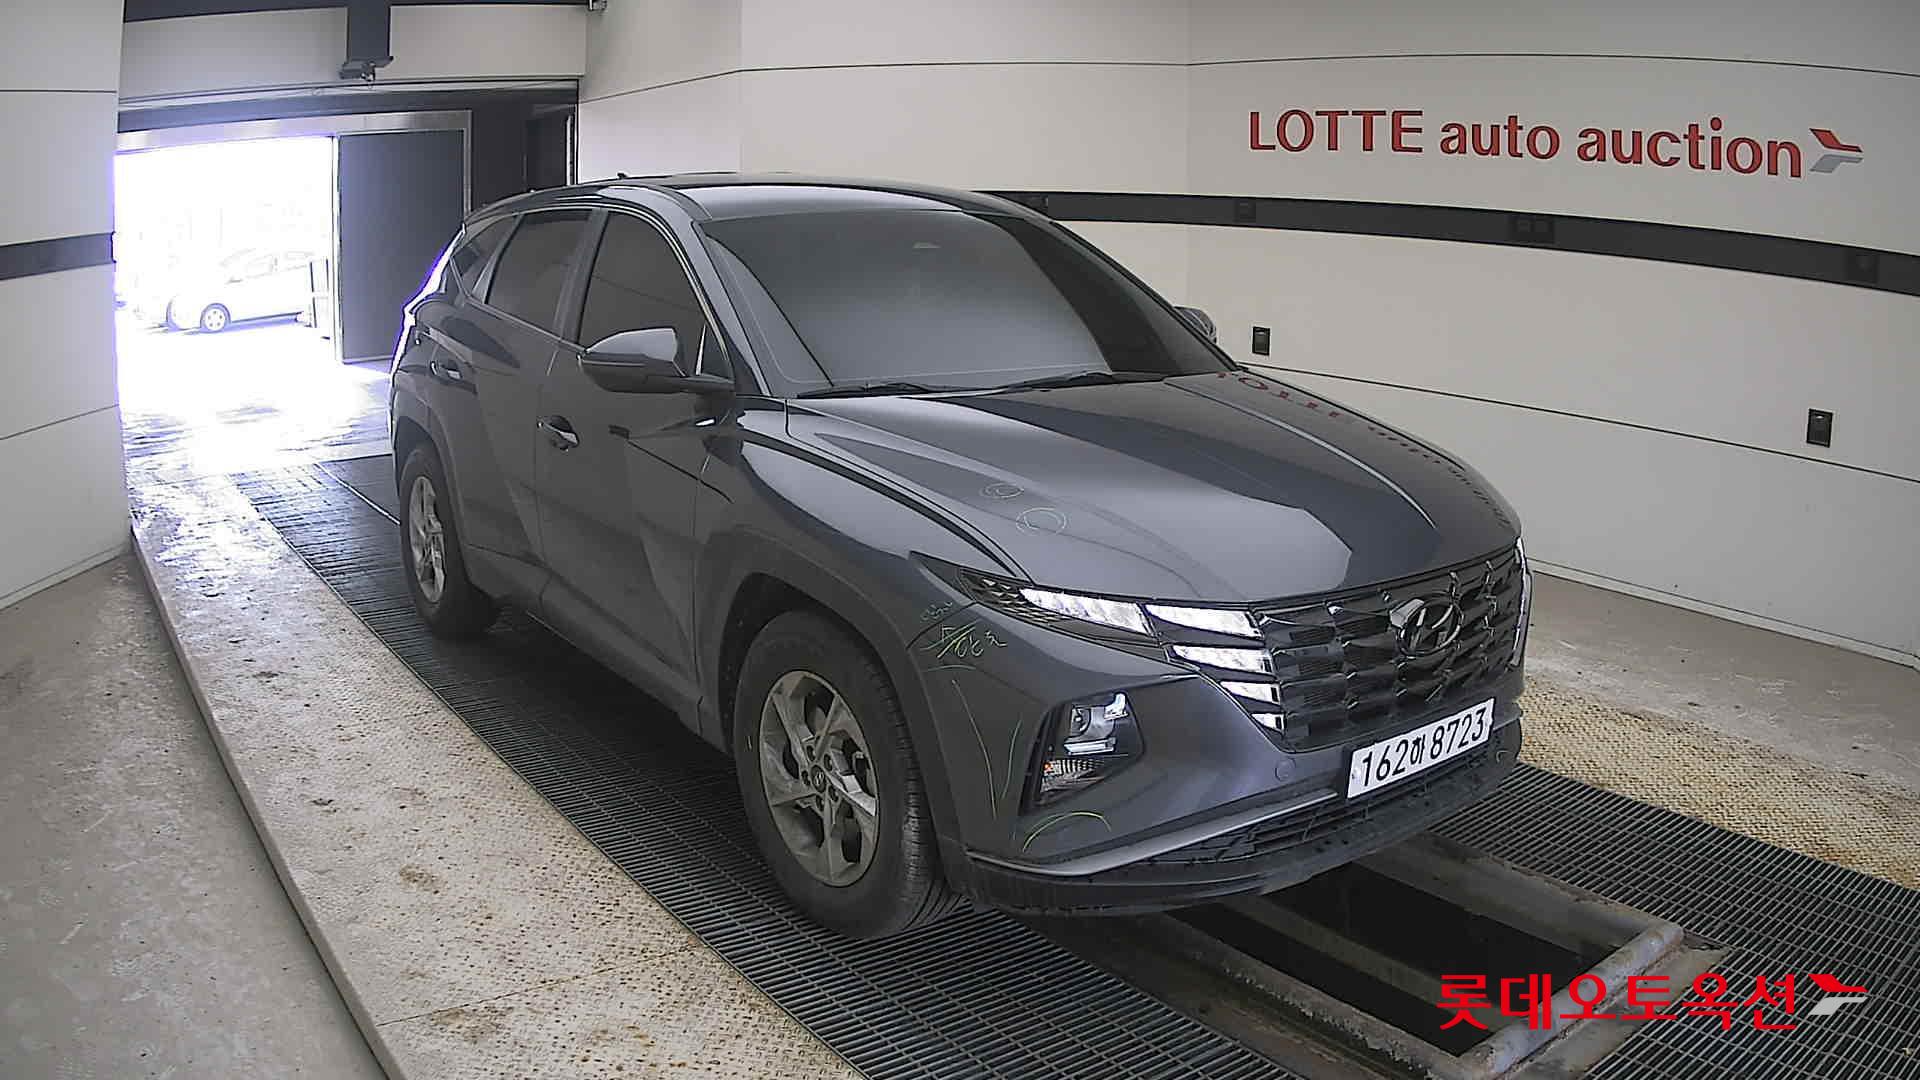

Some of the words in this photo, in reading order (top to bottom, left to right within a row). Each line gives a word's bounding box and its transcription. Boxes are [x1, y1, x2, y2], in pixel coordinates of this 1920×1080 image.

[1248, 109, 1424, 154] LOTTE
[1439, 114, 1561, 161] auto
[1575, 116, 1803, 180] auction
